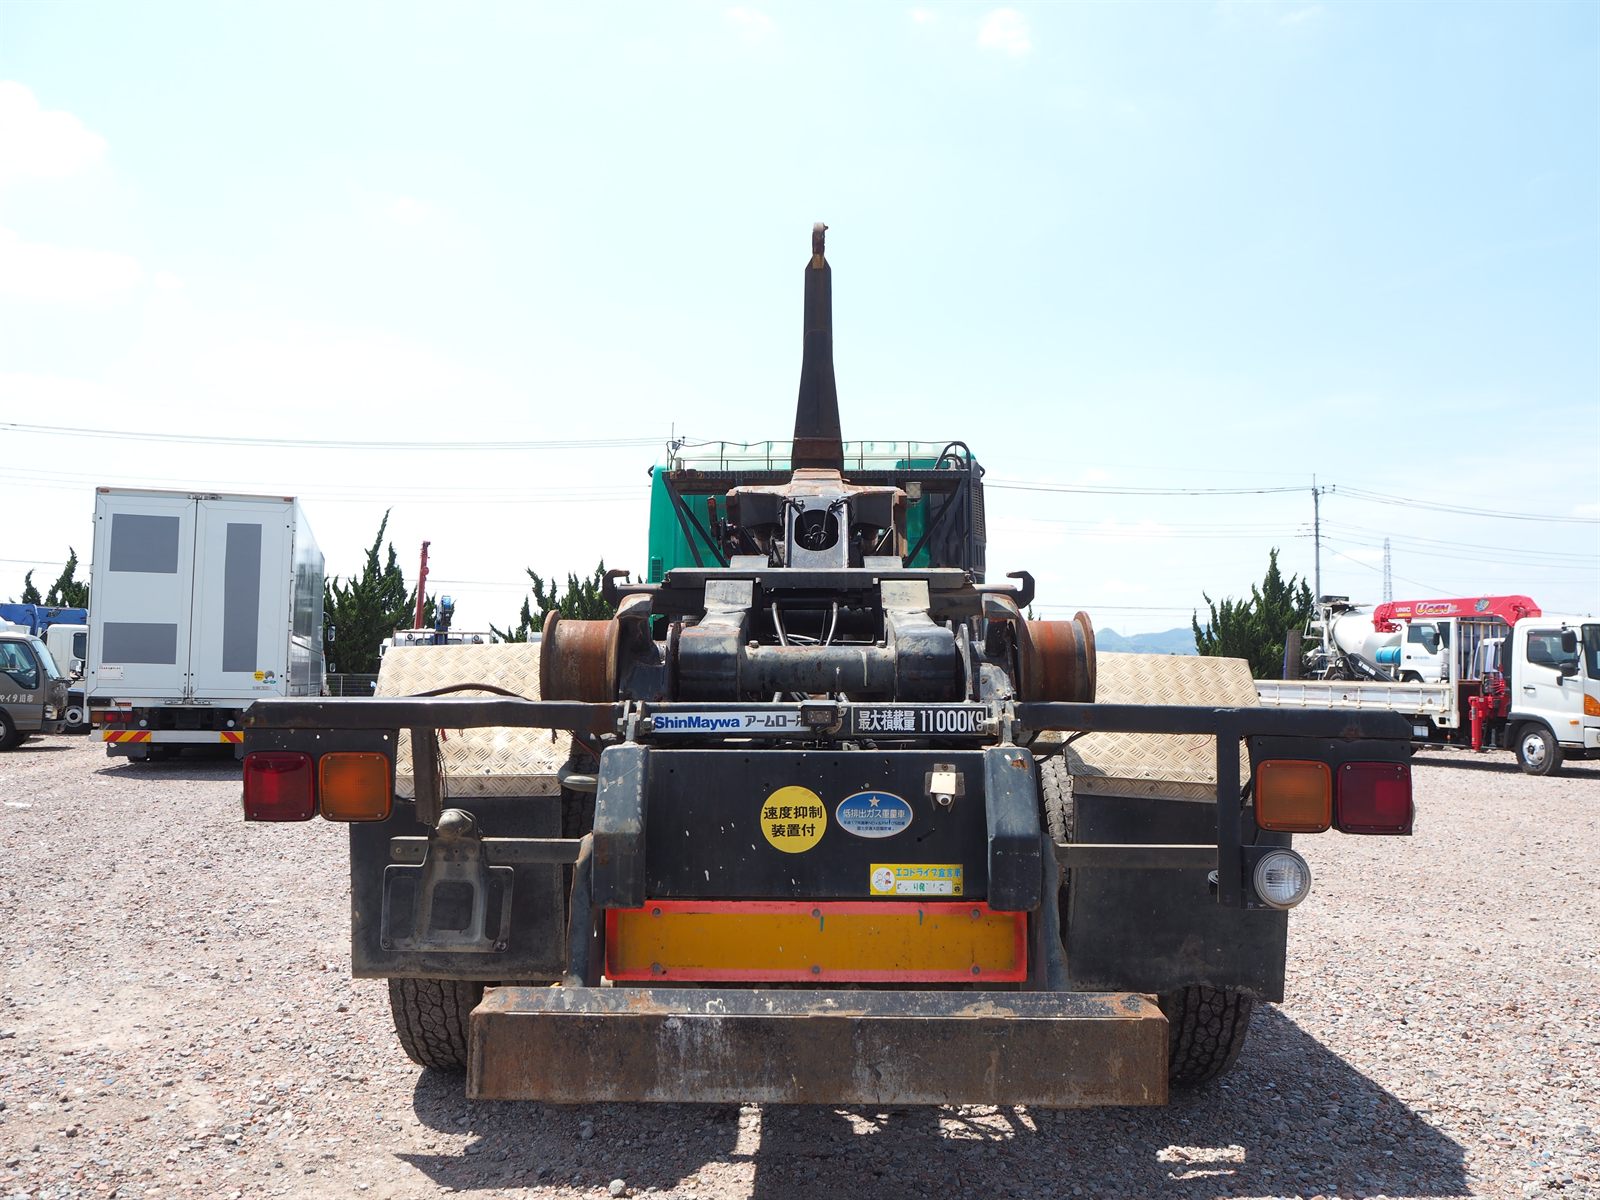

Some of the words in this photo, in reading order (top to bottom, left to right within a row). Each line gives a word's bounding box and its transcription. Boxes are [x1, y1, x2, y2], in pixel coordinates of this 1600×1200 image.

[654, 716, 740, 731] ShinMaywa
[858, 709, 916, 731] 最大積載量
[920, 709, 984, 732] 11000Kg
[764, 806, 823, 819] 速度抑制
[843, 809, 905, 818] 低排出ガス重量車
[772, 823, 816, 837] 装置付
